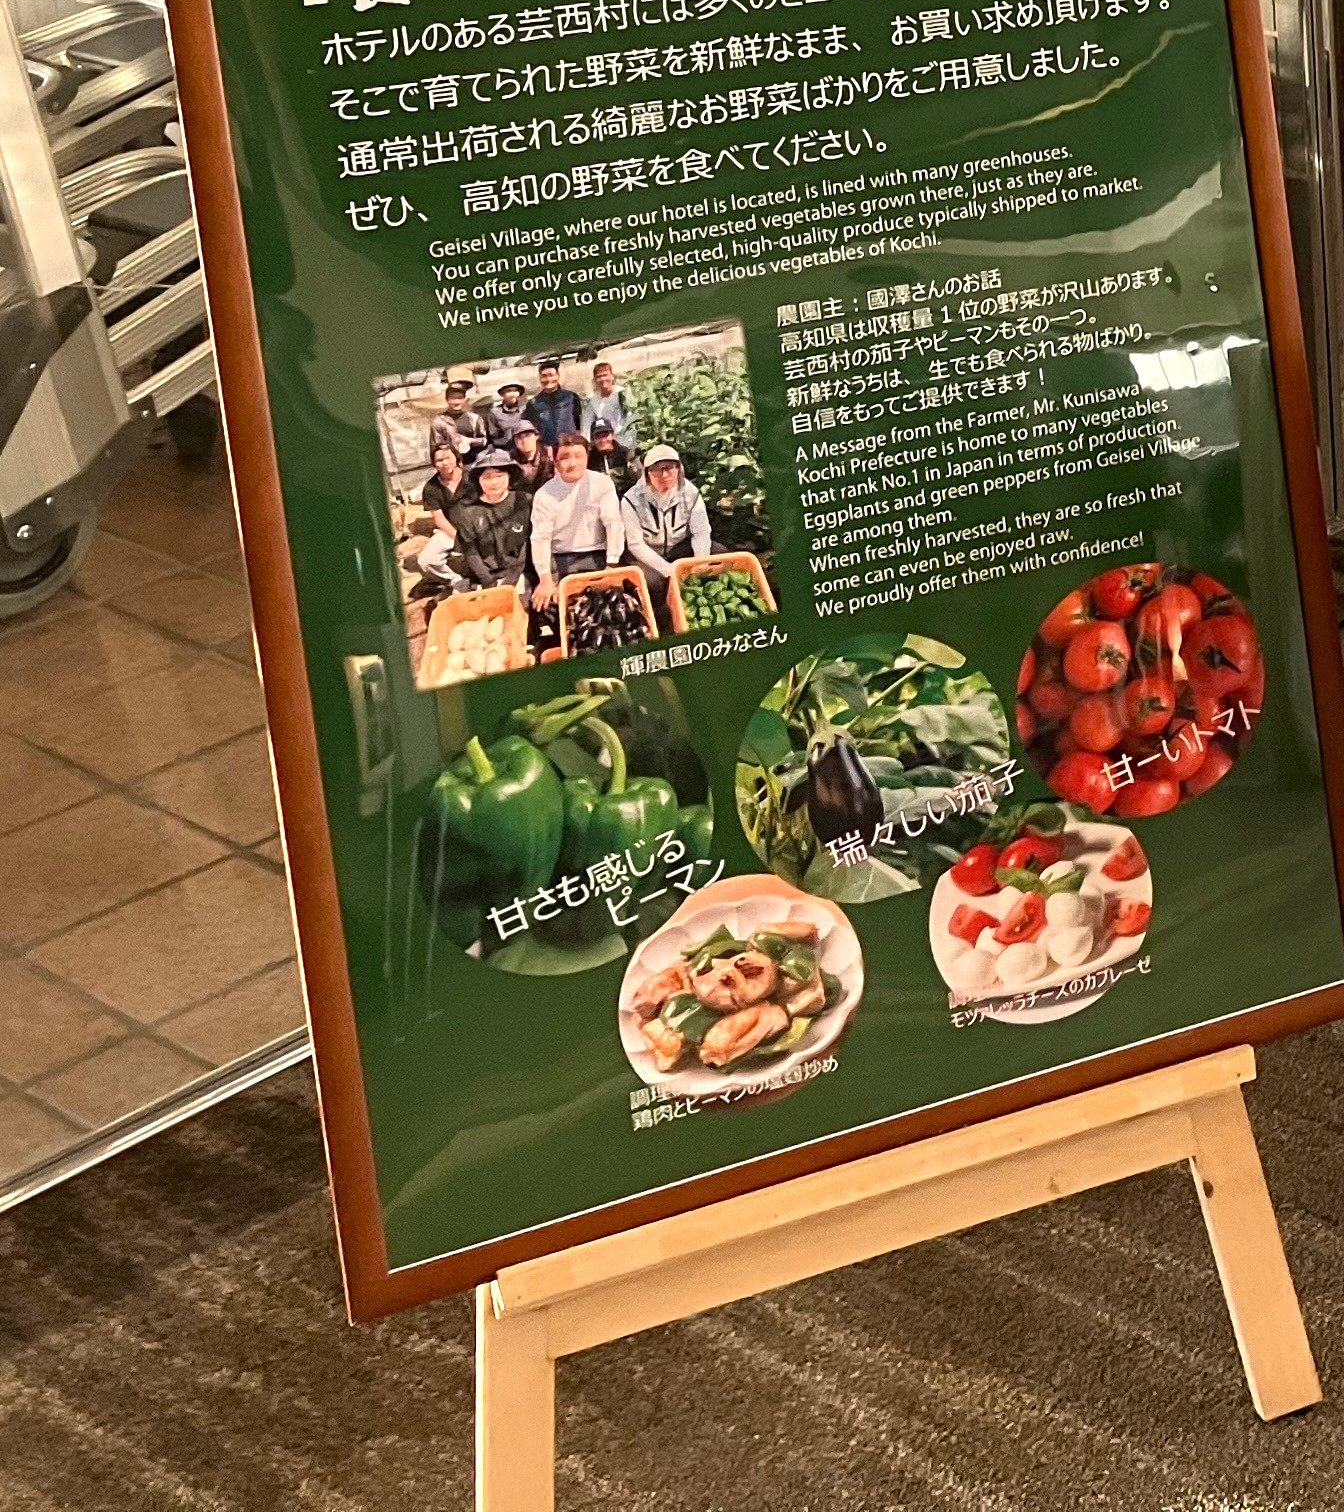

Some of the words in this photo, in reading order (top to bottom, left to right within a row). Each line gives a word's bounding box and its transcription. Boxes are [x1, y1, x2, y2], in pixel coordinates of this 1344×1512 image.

[337, 39, 1121, 179] 通常出荷される綺麗なお野菜ばかりをご用意しました。
[428, 233, 487, 258] Geisei
[489, 226, 560, 248] Village,
[562, 216, 622, 237] where
[626, 210, 658, 227] our
[661, 198, 709, 222] hotel
[730, 184, 801, 211] located,
[821, 173, 865, 196] lined
[868, 168, 908, 189] with
[911, 163, 959, 183] many
[962, 145, 1073, 178] greenhouses.
[431, 263, 470, 282] You
[474, 258, 509, 275] can
[513, 242, 600, 273] purchase
[602, 230, 664, 254] freshly
[667, 213, 757, 244] harvested
[760, 200, 856, 230] vegetables
[859, 193, 916, 217] grown
[918, 184, 969, 203] there,
[971, 176, 1002, 199] just
[1026, 167, 1064, 186] they
[1067, 164, 1098, 180] are.
[434, 285, 468, 305] We
[471, 278, 517, 299] offer
[520, 269, 562, 291] only
[566, 256, 644, 284] carefully
[648, 241, 729, 271] selected,
[731, 226, 838, 258] high-quality
[842, 214, 914, 242] produce
[917, 200, 987, 229] typically
[990, 187, 1057, 214] shipped
[1082, 176, 1143, 198] market.
[437, 308, 471, 329] We
[474, 300, 529, 323] invite
[532, 295, 569, 317] you
[572, 291, 593, 306] to
[596, 281, 648, 303] enjoy
[651, 274, 683, 293] the
[686, 262, 766, 287] delicious
[767, 244, 865, 274] vegetables
[867, 237, 887, 256] of
[888, 229, 942, 253] Kochi.
[782, 310, 1098, 381] 芸西村の茄子やピーマンもその一つ。
[791, 367, 1046, 435] 自信をもってご提供できます！
[796, 460, 846, 485] Kochi
[849, 445, 937, 474] Prefecture
[956, 431, 1007, 453] home
[1009, 427, 1028, 442] to
[1031, 417, 1078, 438] many
[1080, 398, 1169, 428] vegetables
[811, 433, 887, 460] Message
[889, 424, 931, 444] from
[933, 417, 963, 435] the
[966, 404, 1030, 428] Farmer,
[1032, 397, 1060, 415] Mr.
[1062, 382, 1140, 408] Kunisawa
[798, 486, 837, 507] that
[839, 476, 879, 500] rank
[880, 467, 918, 491] No.1
[923, 465, 941, 482] in
[944, 456, 994, 478] Japan
[996, 450, 1014, 467] in
[1016, 441, 1064, 462] terms
[1067, 432, 1084, 452] of
[1087, 418, 1181, 452] production.
[802, 499, 890, 532] Eggplants
[893, 488, 926, 511] and
[929, 481, 979, 507] green
[982, 466, 1050, 496] peppers
[1052, 457, 1093, 477] from
[1095, 443, 1145, 467] Geisei
[1146, 435, 1200, 457] Village
[808, 551, 861, 574] When
[863, 535, 921, 562] freshly
[923, 515, 1012, 549] harvested,
[1014, 510, 1051, 529] they
[1054, 504, 1080, 520] are
[1083, 499, 1103, 514] so
[1105, 487, 1146, 509] fresh
[1149, 480, 1182, 500] that
[810, 533, 839, 551] are
[841, 519, 904, 544] among
[906, 509, 957, 530] them.
[812, 574, 860, 596] some
[863, 566, 895, 584] can
[898, 556, 940, 577] even
[942, 550, 966, 567] be
[968, 531, 1036, 562] enjoyed
[1039, 528, 1074, 546] raw.
[814, 598, 844, 618] We
[847, 582, 914, 614] proudly
[917, 573, 958, 595] offer
[960, 564, 1006, 585] them
[1008, 552, 1046, 574] with
[1049, 529, 1144, 566] confidence!
[620, 624, 789, 680] 輝農園のみなさん
[1100, 704, 1262, 793] 甘ーいトマト
[824, 758, 1025, 870] 瑞々しい茄子
[486, 828, 686, 941] 甘さも感じる
[606, 857, 727, 928] ピーマン
